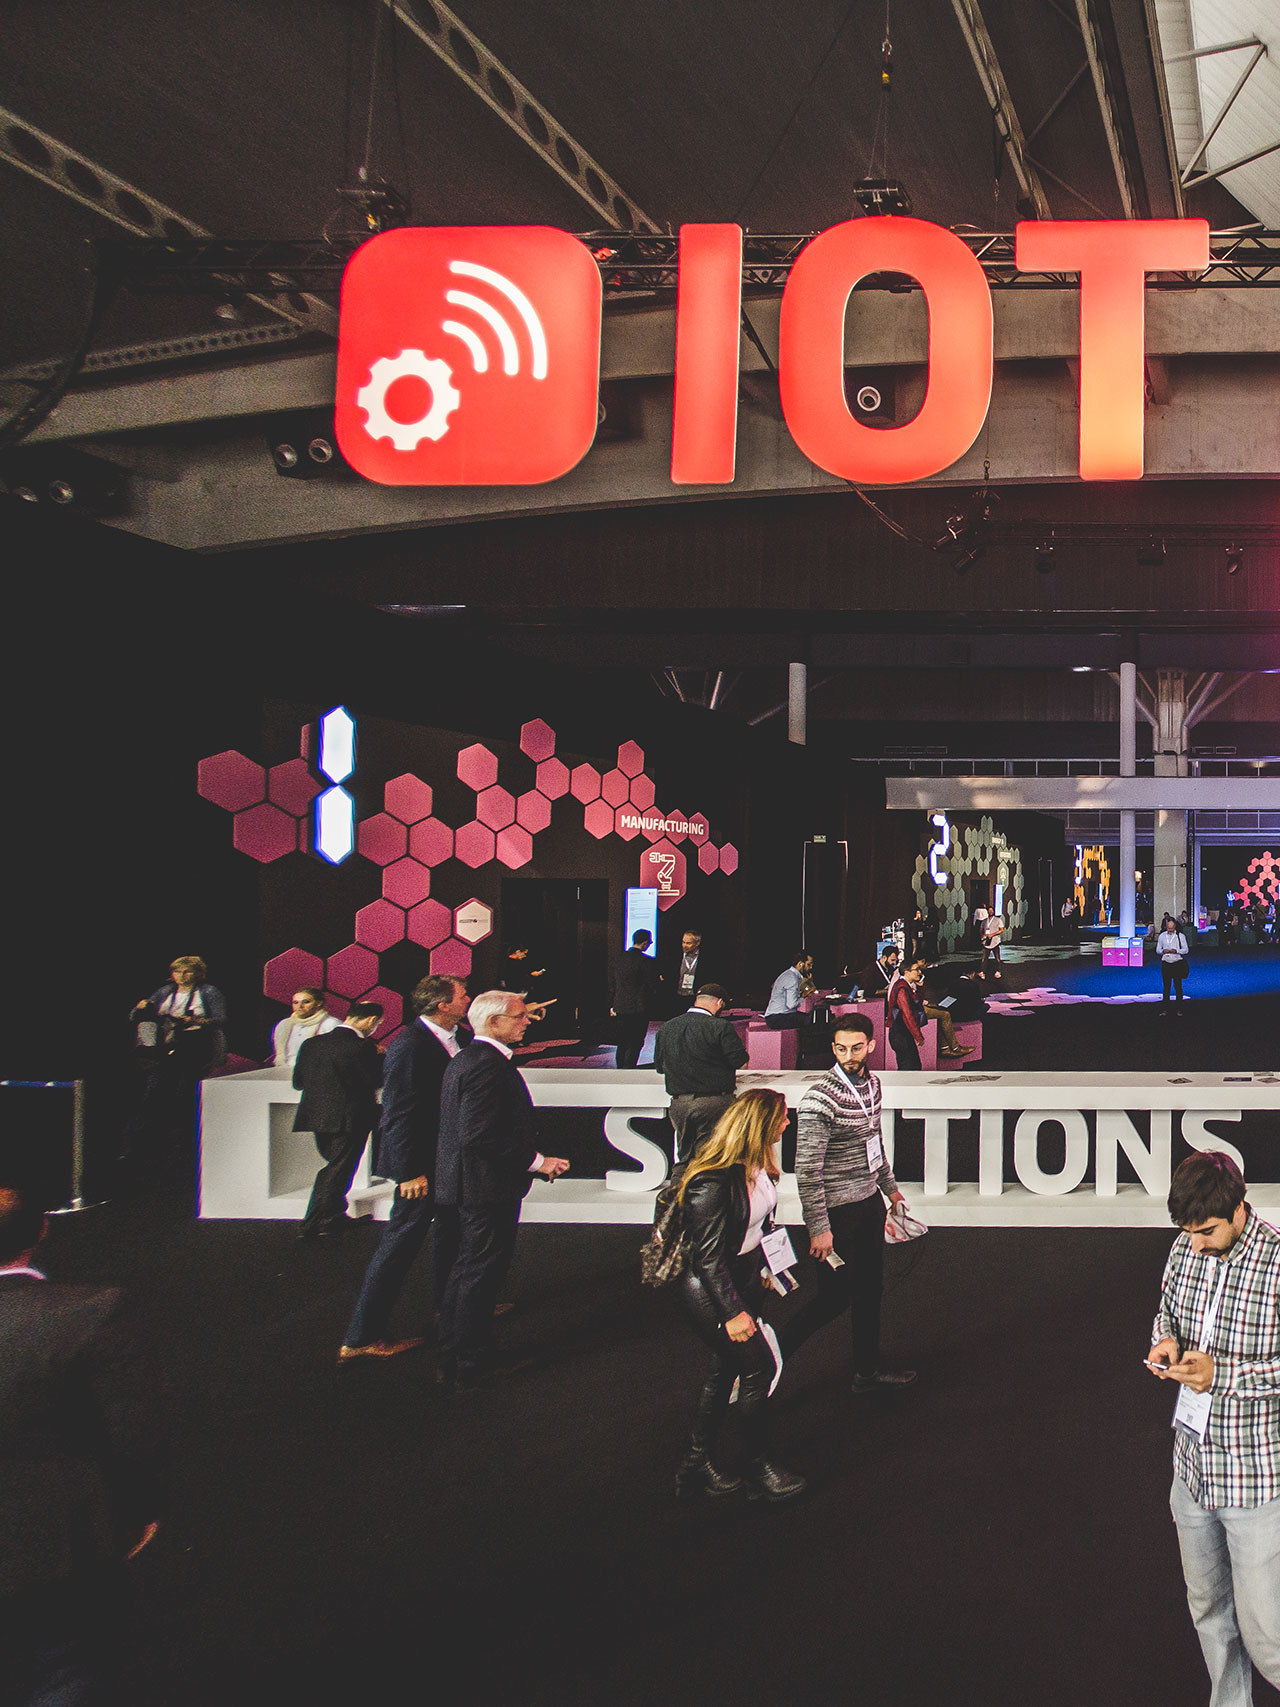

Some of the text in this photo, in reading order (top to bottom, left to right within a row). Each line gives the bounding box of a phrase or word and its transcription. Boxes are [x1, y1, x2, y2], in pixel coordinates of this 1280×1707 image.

[671, 216, 1210, 485] IOT
[621, 814, 704, 835] MANUFACTURING
[930, 814, 949, 885] 2
[603, 1107, 1246, 1196] STIONS
